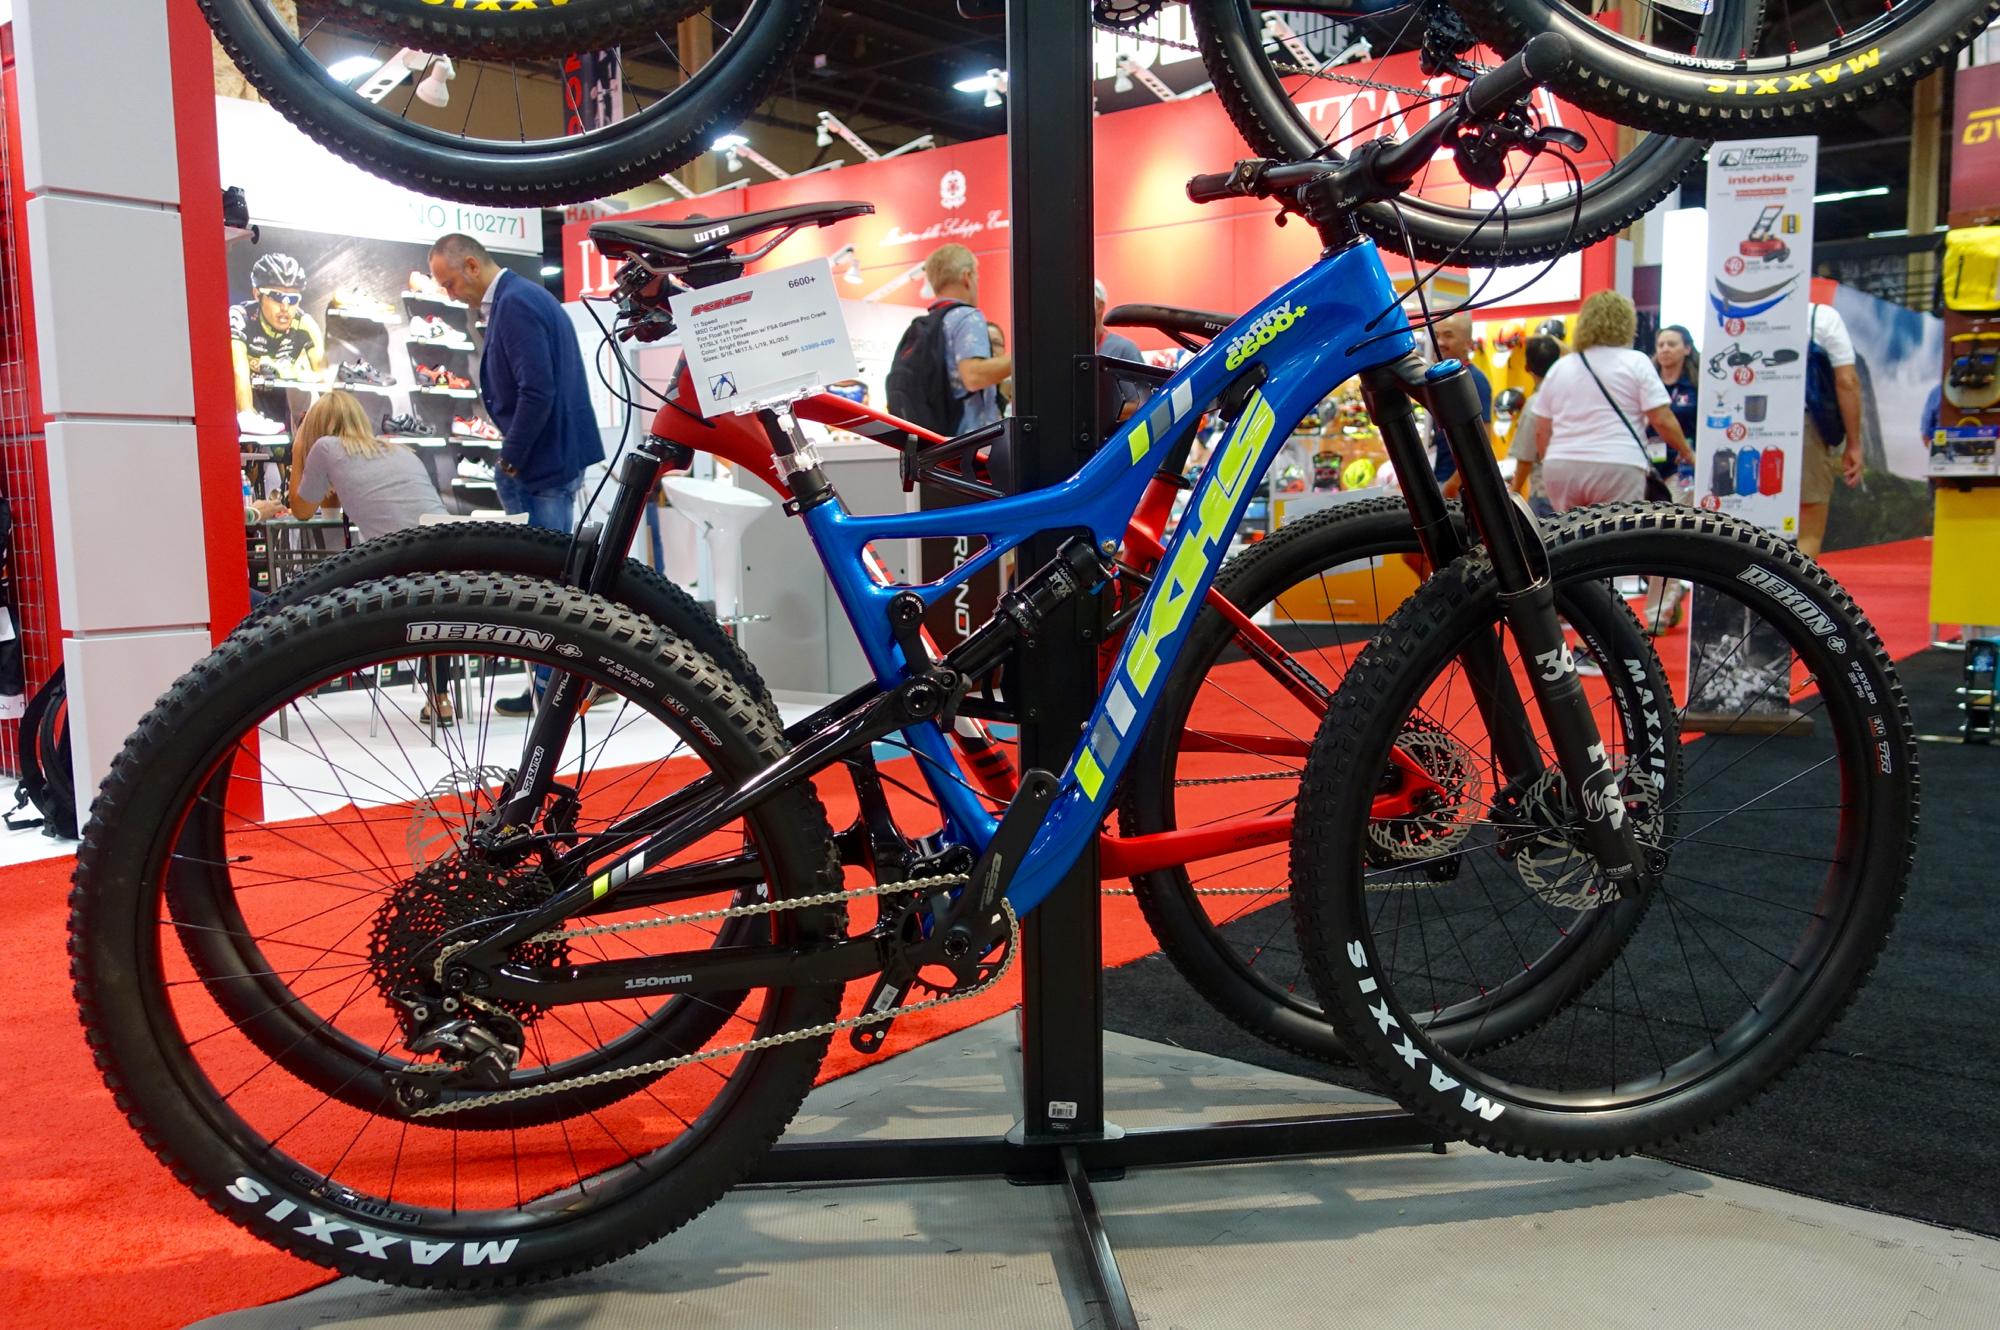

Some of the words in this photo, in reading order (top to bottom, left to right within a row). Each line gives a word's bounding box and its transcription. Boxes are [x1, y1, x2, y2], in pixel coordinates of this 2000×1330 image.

[1707, 48, 1881, 95] MAXXIS
[1745, 146, 1797, 157] Liberty
[1728, 174, 1795, 185] interbike
[694, 224, 730, 243] WTB
[788, 275, 816, 289] 6600+
[697, 335, 708, 343] Fox
[708, 331, 723, 340] Float
[730, 326, 744, 334] Fork
[700, 318, 718, 328] Speed
[709, 323, 729, 333] Carbon
[729, 317, 748, 327] Frame
[732, 329, 760, 342] Drivetrain
[766, 323, 779, 332] FSA
[779, 318, 801, 329] Gamma
[811, 311, 827, 320] Crank
[1225, 299, 1291, 354] sixfifty
[1225, 305, 1308, 371] 6600+
[701, 347, 718, 356] Color:
[718, 341, 736, 352] Bright
[736, 338, 750, 347] Blue
[781, 347, 800, 357] MSRP:
[1127, 388, 1275, 698] KHS
[1048, 571, 1072, 599] FOX
[1737, 564, 1837, 636] REKON
[407, 621, 554, 651] REKON
[598, 655, 656, 689] 27.5X2.80
[1536, 642, 1576, 681] 36
[623, 674, 641, 688] PSI
[1850, 660, 1878, 705] 27.5X2.80
[1855, 684, 1866, 698] PSI
[1624, 658, 1666, 791] MAXXIS
[528, 746, 545, 782] SUNTOUR
[624, 973, 693, 989] 150mm
[1346, 939, 1506, 1122] MAXXIS
[225, 1176, 520, 1267] MAXXIS
